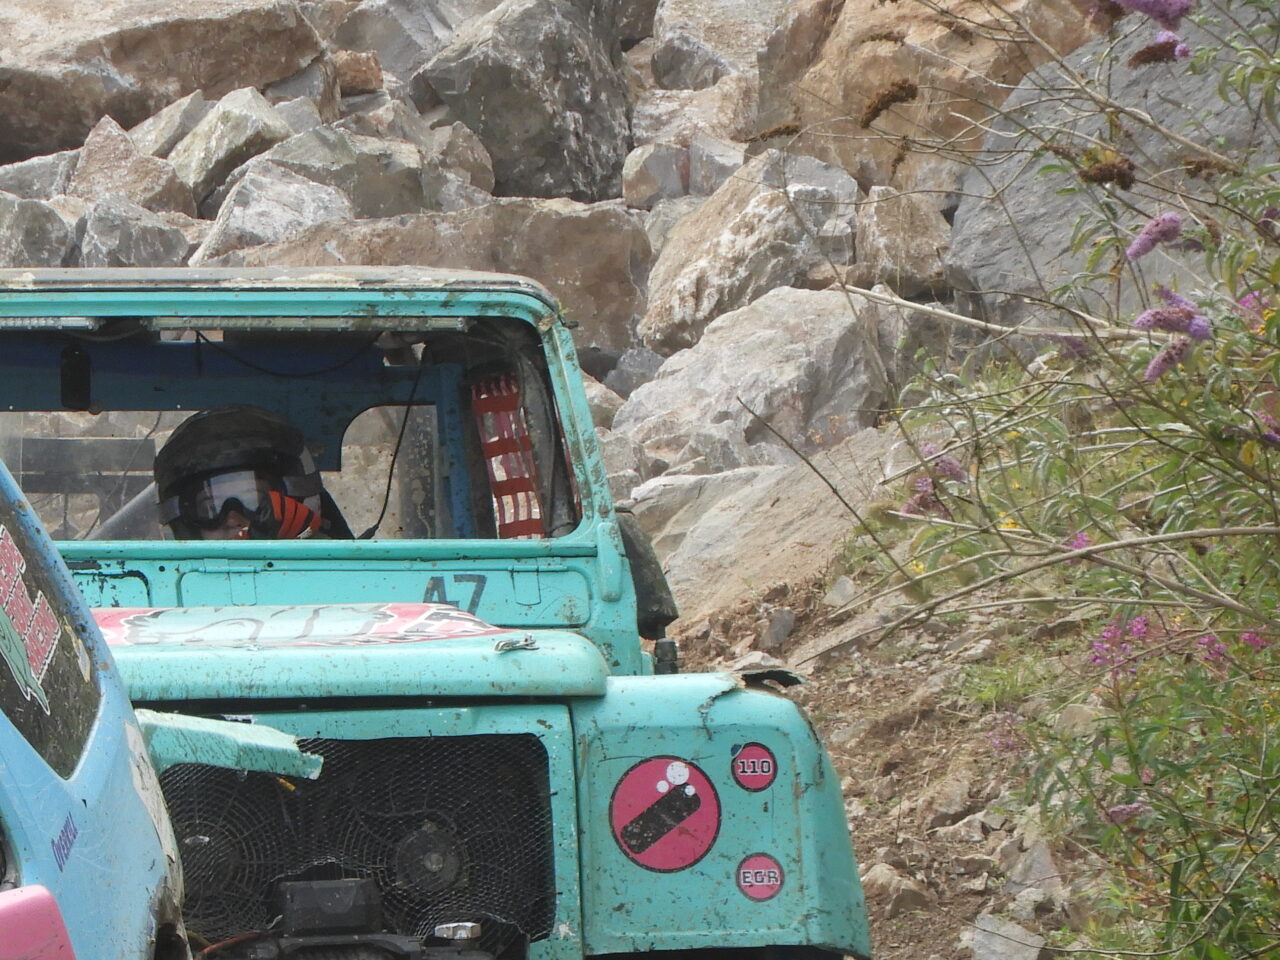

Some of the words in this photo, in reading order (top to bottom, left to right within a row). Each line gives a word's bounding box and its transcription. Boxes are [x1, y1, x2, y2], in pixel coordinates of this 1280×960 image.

[423, 574, 487, 616] 47
[738, 760, 771, 775] 110
[741, 870, 779, 886] EGR
